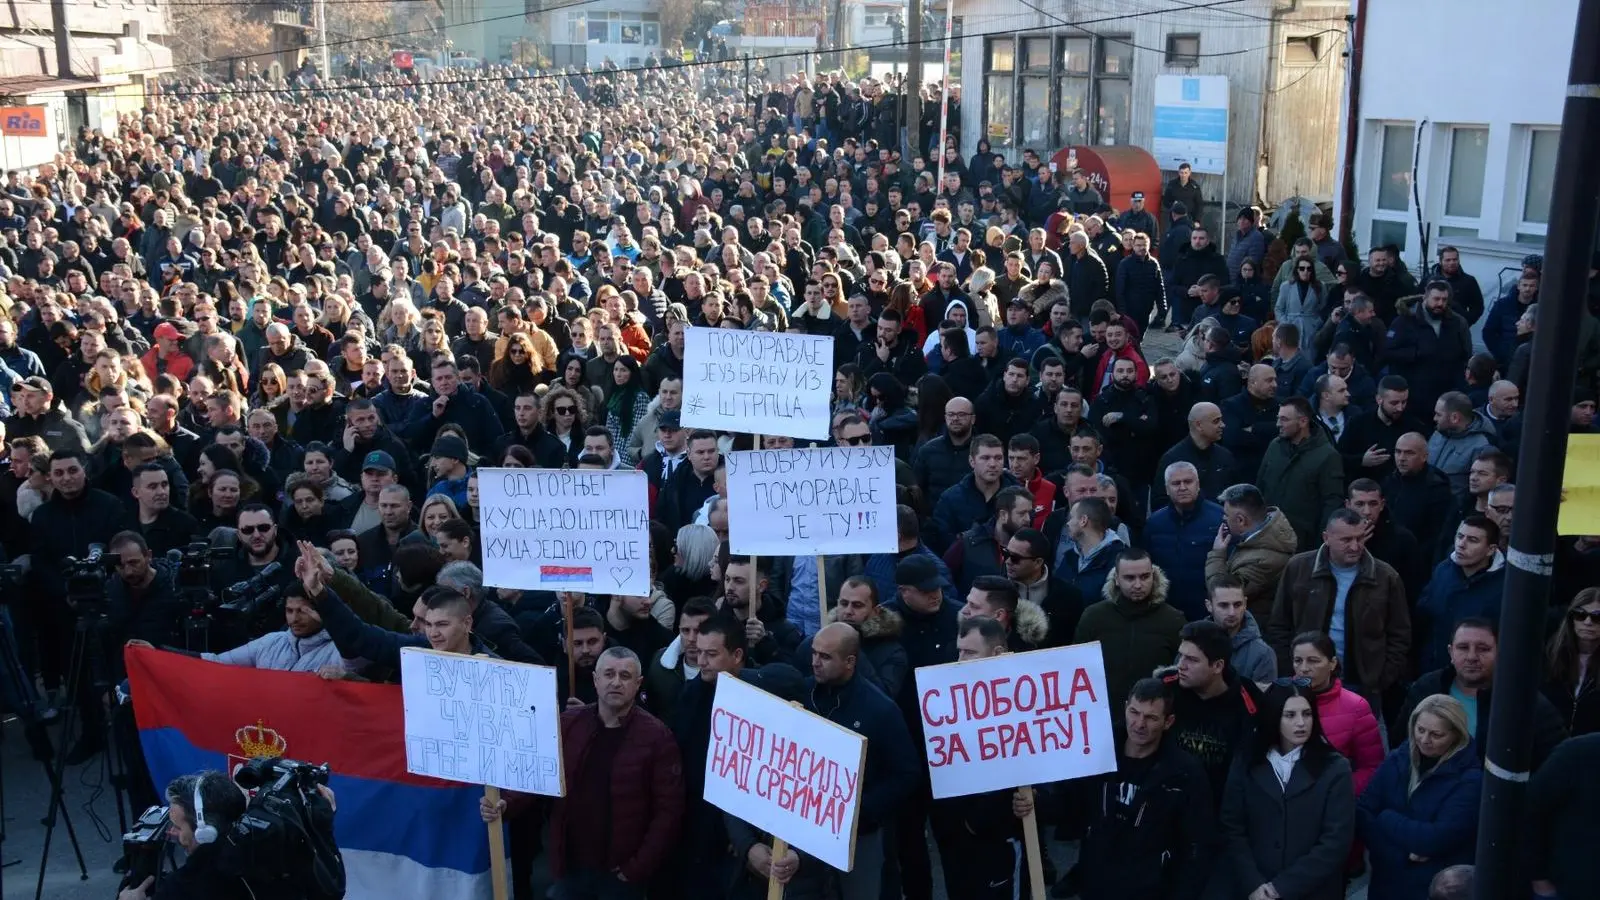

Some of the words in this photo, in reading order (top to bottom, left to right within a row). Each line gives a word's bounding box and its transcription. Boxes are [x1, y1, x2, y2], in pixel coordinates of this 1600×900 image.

[7, 112, 41, 129] Ria
[1090, 172, 1108, 192] 24/7
[708, 332, 825, 365] ПОМОРАВЉЕ
[740, 364, 788, 386] БРАЋУ
[795, 369, 821, 390] ИЗ
[718, 391, 806, 419] ШТРПЦА
[727, 453, 738, 475] У
[749, 450, 812, 475] ДОБРУ
[820, 449, 835, 469] И
[841, 449, 851, 470] У
[857, 447, 892, 469] ЗЛУ
[504, 473, 532, 497] ОД
[537, 473, 613, 497] ГОРЊЕГ
[754, 477, 881, 511] ПОМОРАВЉЕ
[784, 515, 810, 539] ЈЕ
[594, 541, 640, 562] СРЦЕ
[922, 668, 1097, 727] СЛОБОДА
[928, 733, 971, 767] ЗА
[978, 711, 1091, 761] БРАЋУ!
[479, 745, 496, 784] И
[503, 750, 558, 792] МИР
[712, 708, 765, 760] СТОП
[769, 733, 857, 803] НАСИЉУ
[711, 741, 752, 794] НАД
[756, 765, 846, 840] СРБИМА!
